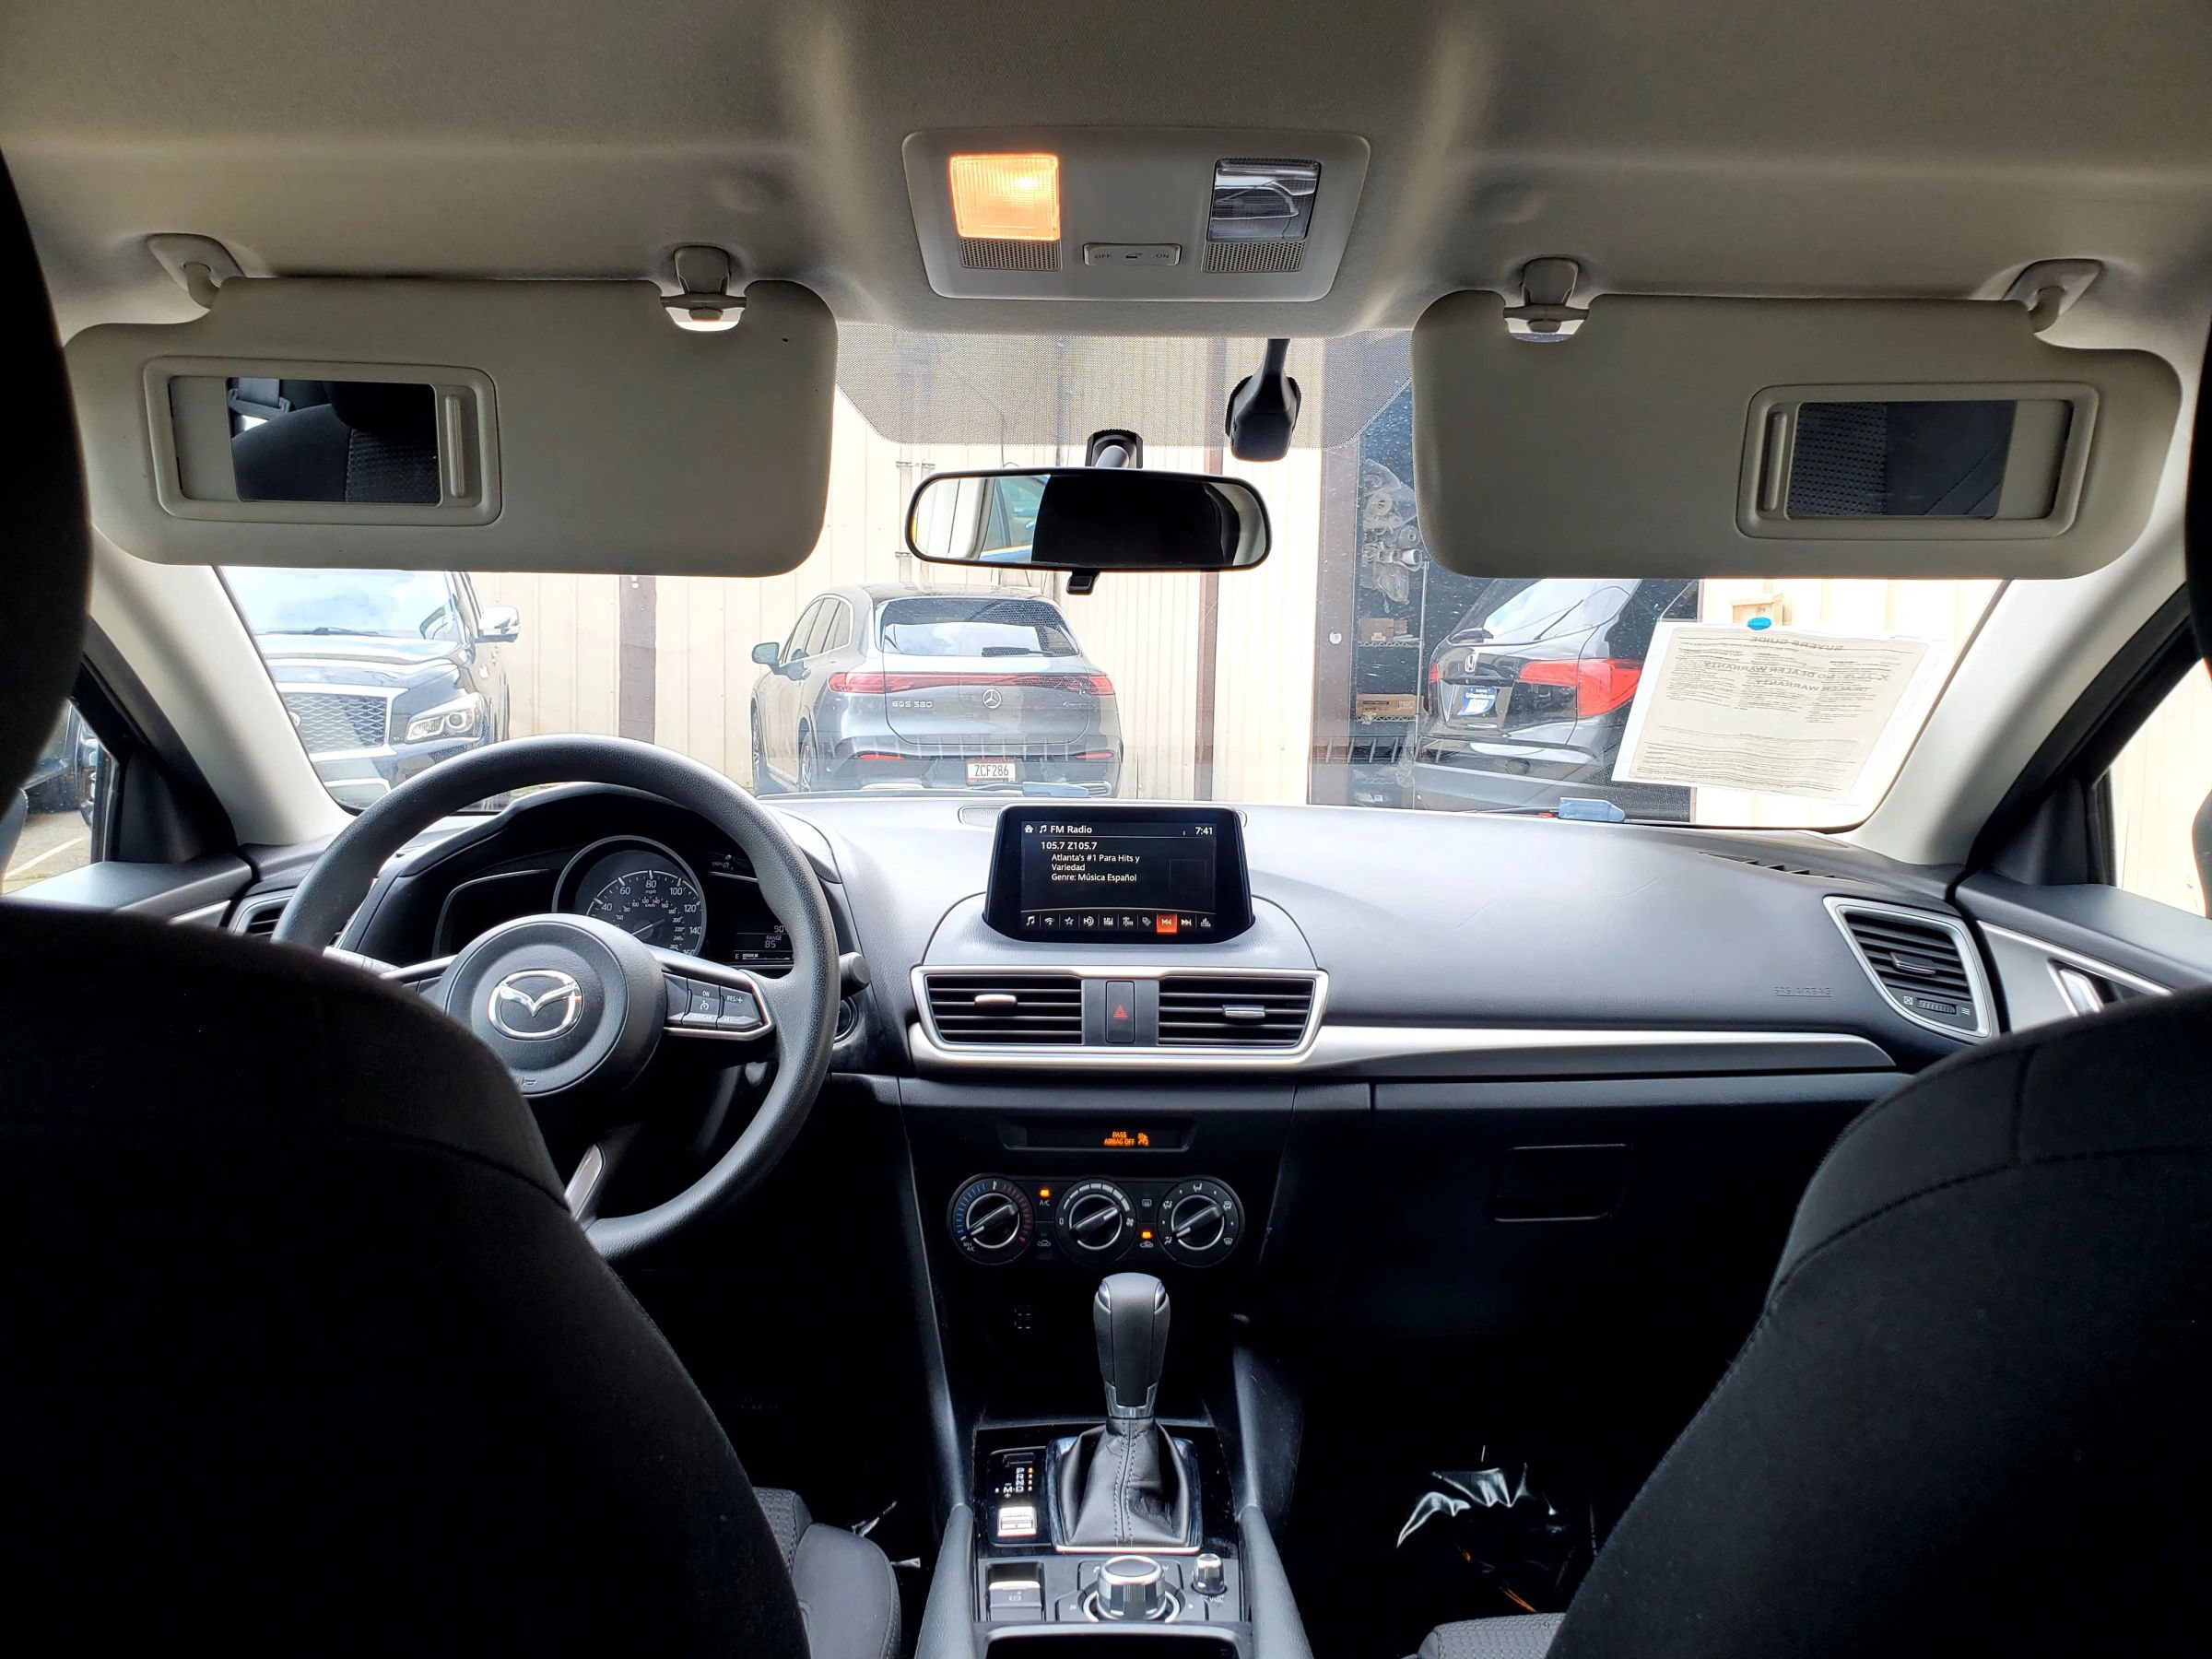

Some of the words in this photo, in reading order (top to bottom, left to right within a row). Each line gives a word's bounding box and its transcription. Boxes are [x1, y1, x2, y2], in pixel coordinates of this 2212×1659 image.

[975, 764, 1008, 776] ZCF286
[1194, 827, 1213, 835] 7:41
[1041, 841, 1065, 850] 105.7
[1067, 841, 1097, 850] Z105.7
[1052, 853, 1084, 862] Atlanta's
[1118, 854, 1133, 863] Hits
[1077, 873, 1105, 881] Música
[1107, 874, 1137, 883] Español
[645, 879, 656, 888] 80
[619, 887, 630, 895] 60
[670, 887, 682, 895] 100
[684, 904, 696, 912] 120
[689, 926, 701, 935] 140
